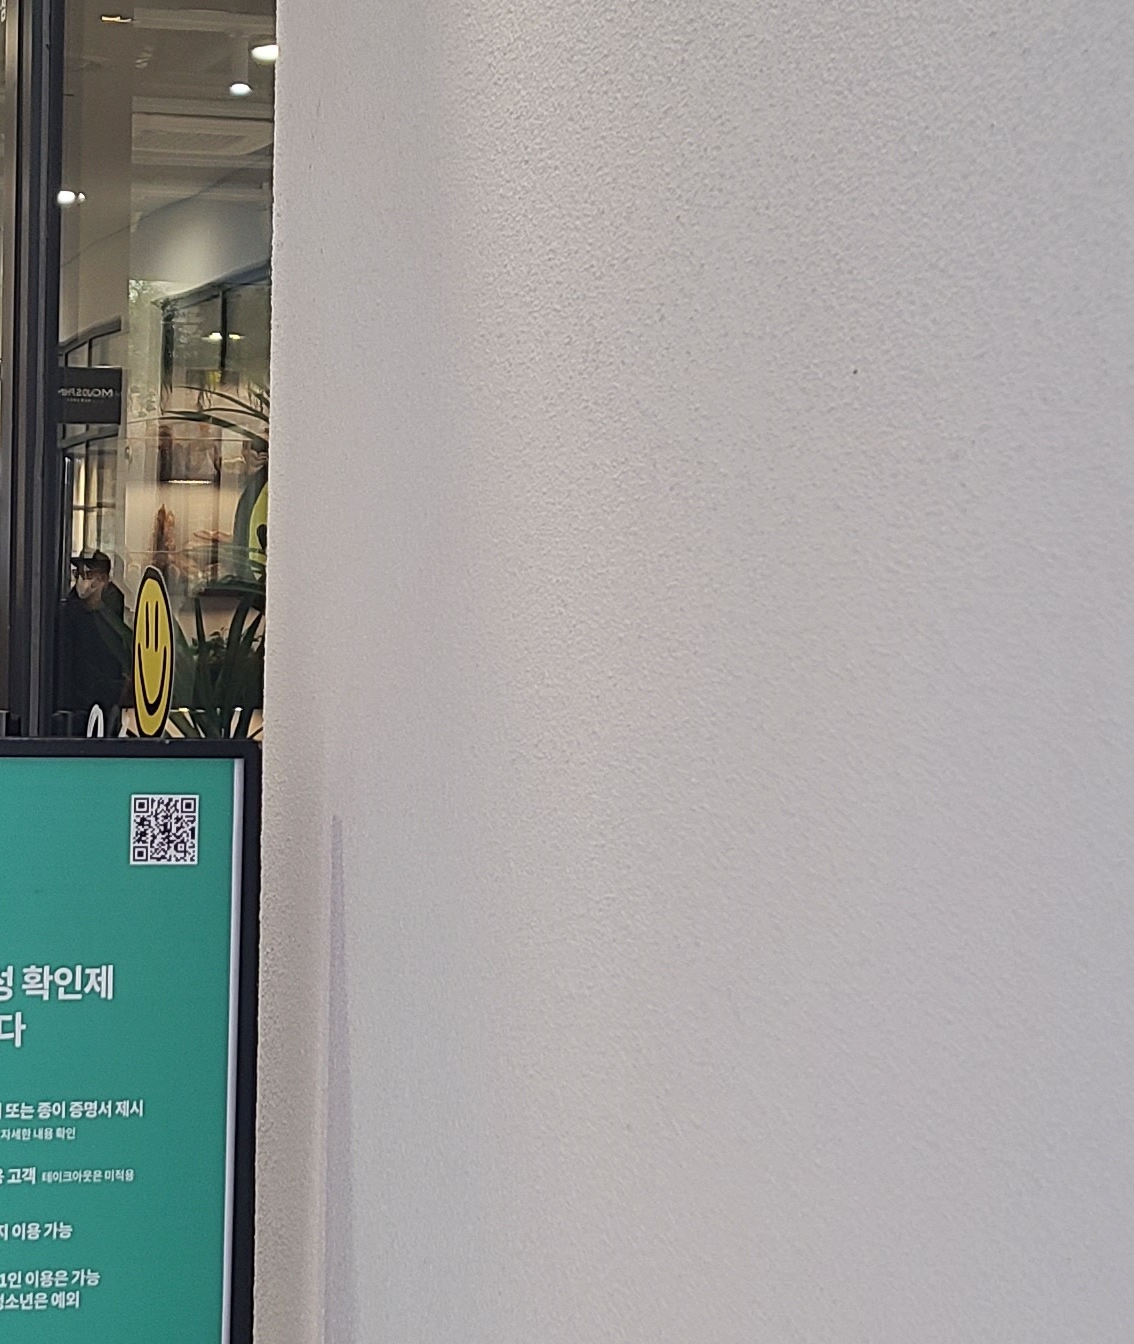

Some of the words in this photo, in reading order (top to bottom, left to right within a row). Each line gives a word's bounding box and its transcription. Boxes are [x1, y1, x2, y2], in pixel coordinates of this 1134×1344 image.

[21, 964, 114, 1001] 확인제
[5, 1102, 34, 1120] 또는
[37, 1101, 66, 1119] 종이
[69, 1100, 112, 1118] 증명서
[115, 1099, 144, 1117] 제시
[1, 1128, 31, 1141] 자세한
[33, 1127, 53, 1140] 내용
[56, 1127, 76, 1140] 확인
[7, 1167, 36, 1185] 고객
[41, 1170, 103, 1183] 테이크아웃은
[104, 1169, 134, 1182] 미적용
[12, 1223, 41, 1241] 이용
[44, 1222, 73, 1240] 가능
[0, 1271, 22, 1289] 1인
[25, 1270, 69, 1288] 이용은
[71, 1269, 100, 1286] 가능
[51, 1291, 79, 1309] 예외
